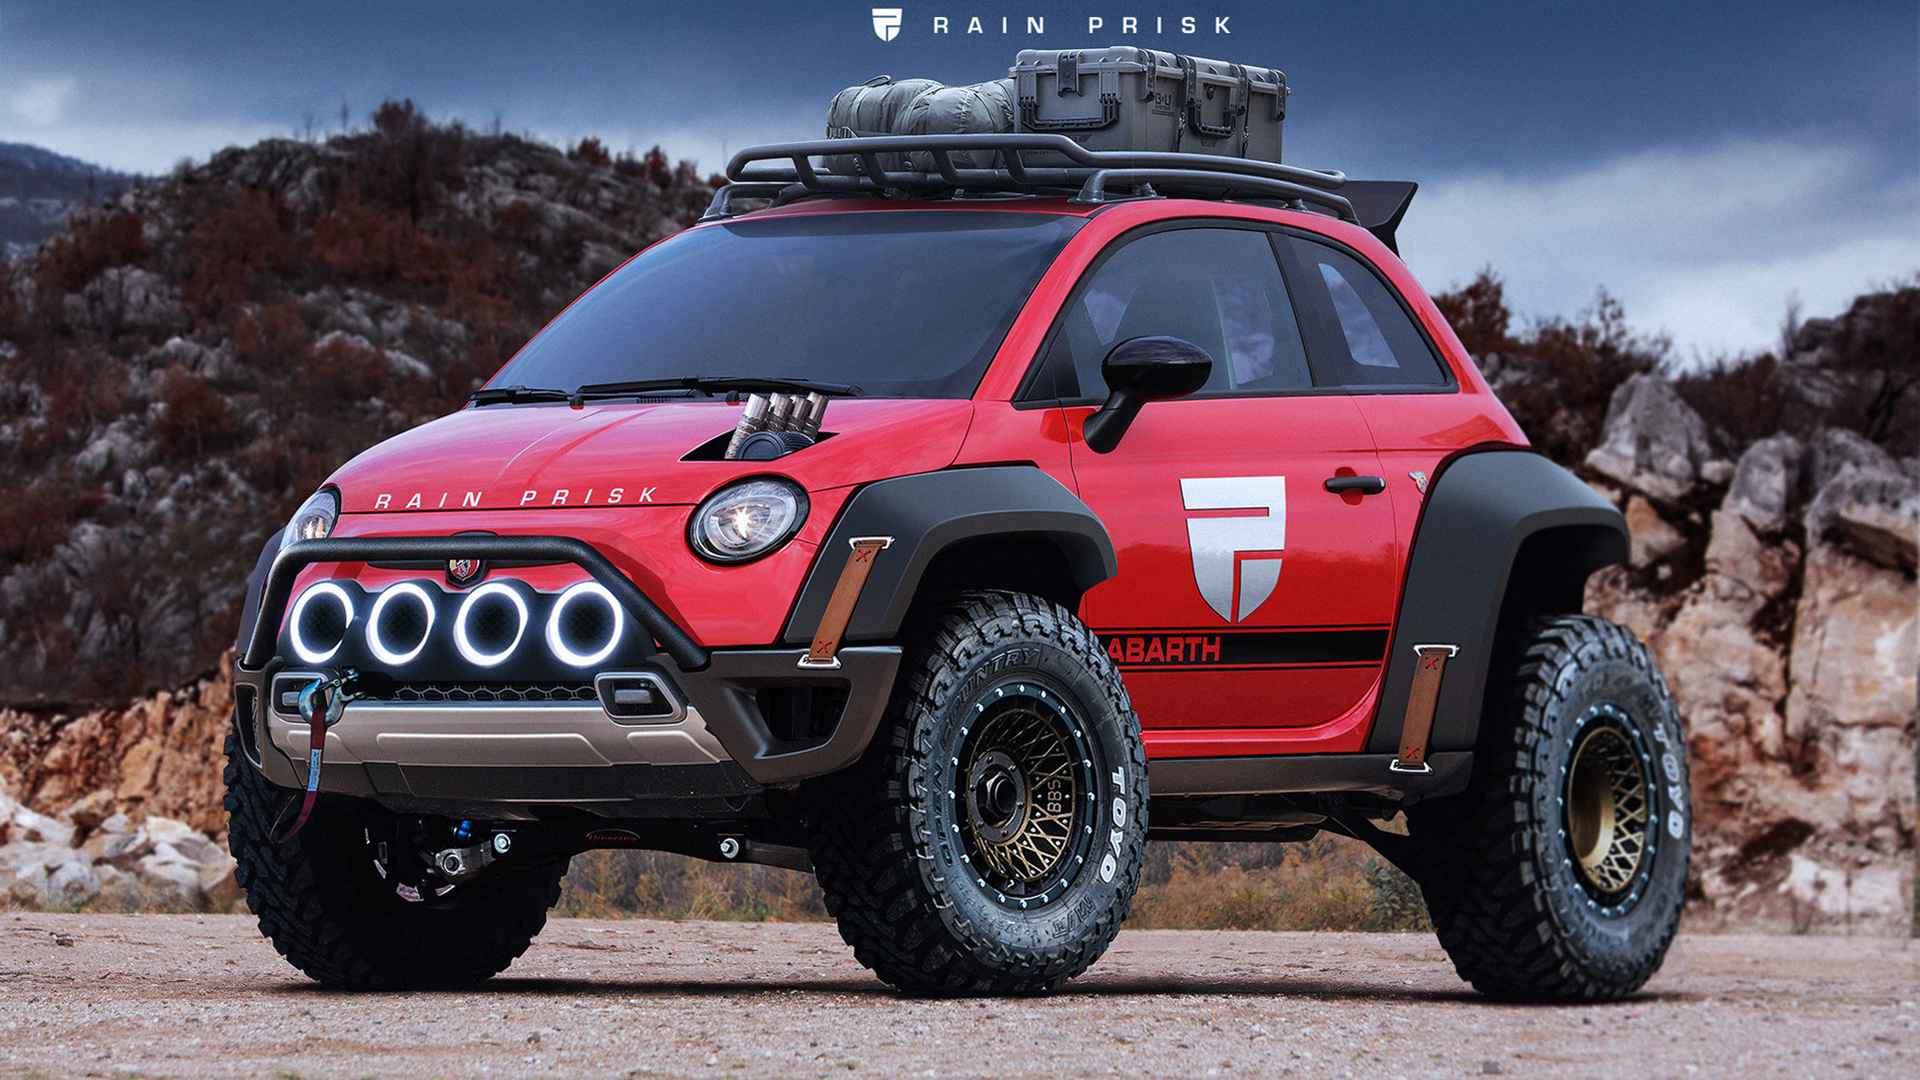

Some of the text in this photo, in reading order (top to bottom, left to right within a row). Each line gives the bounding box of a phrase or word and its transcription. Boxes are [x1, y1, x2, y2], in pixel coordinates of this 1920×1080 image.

[374, 486, 657, 509] RAIN PRISK
[1107, 636, 1221, 663] ABARTH
[1047, 779, 1062, 813] BBS
[1653, 721, 1685, 840] TOYO
[1100, 765, 1126, 883] TOYO
